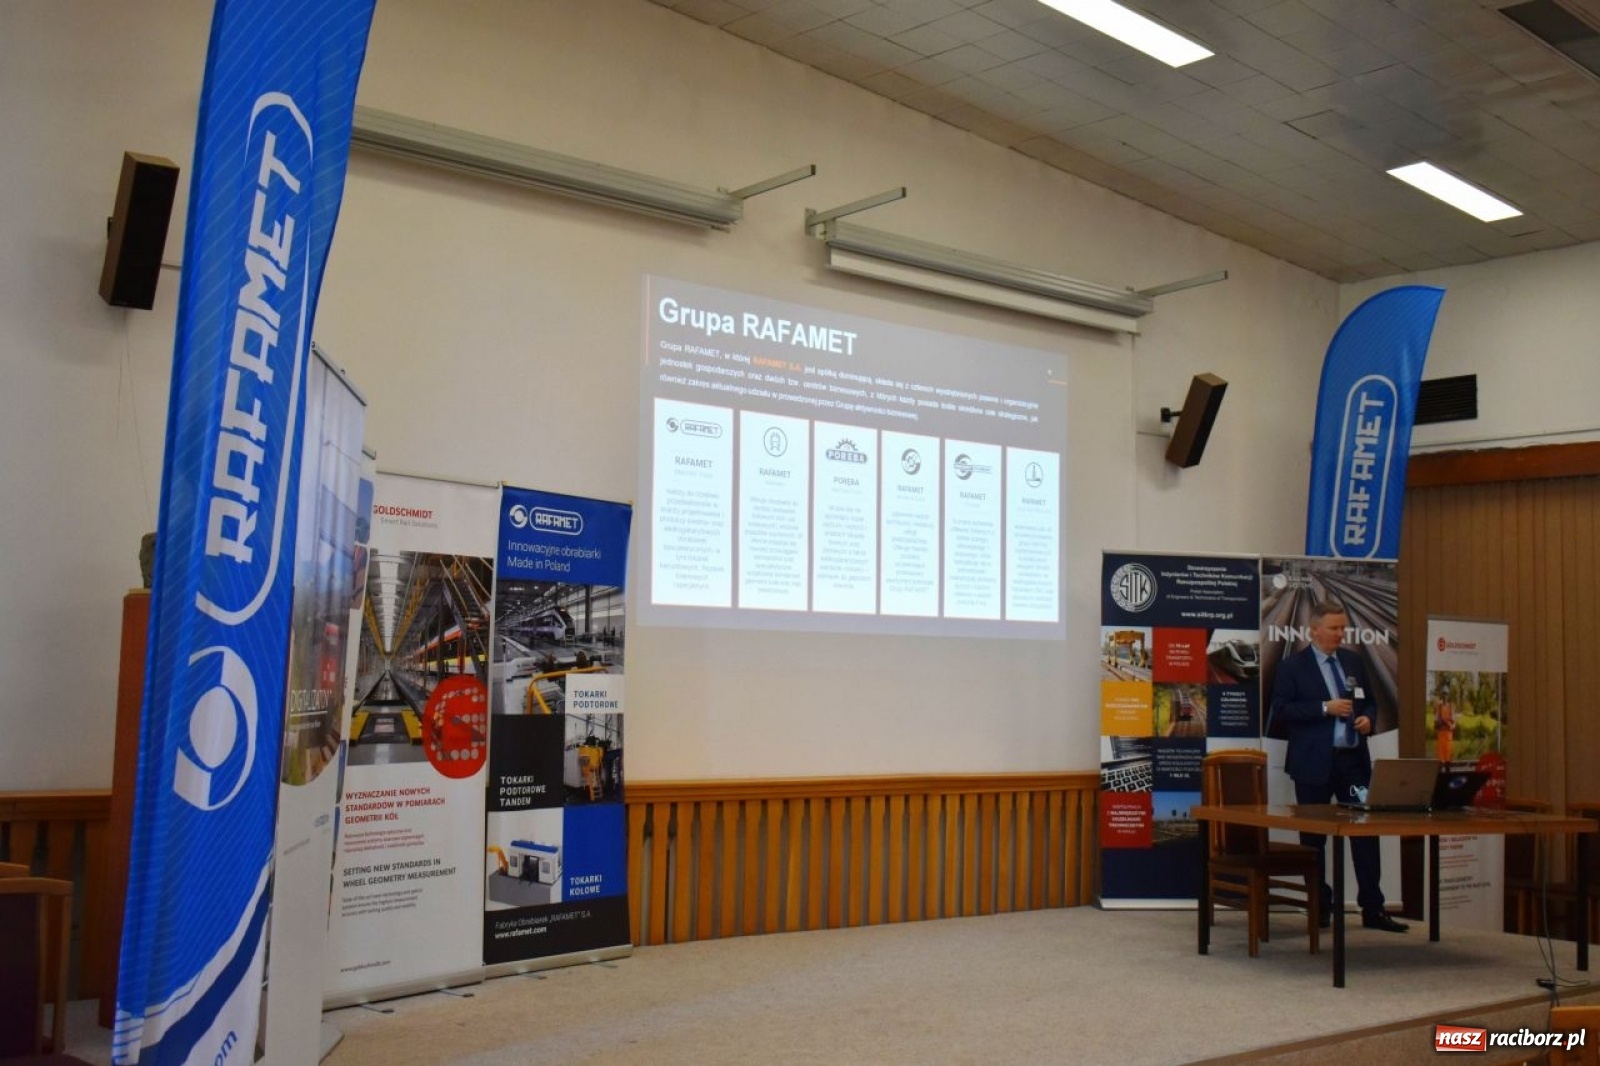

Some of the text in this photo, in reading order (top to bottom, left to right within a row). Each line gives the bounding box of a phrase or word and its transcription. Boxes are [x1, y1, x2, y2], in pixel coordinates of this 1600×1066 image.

[659, 297, 858, 355] Grupa RAFAMET
[205, 130, 300, 563] RAFAMET
[685, 422, 719, 435] RAFAMET
[674, 455, 713, 468] RAFAMET
[759, 468, 791, 479] RAFAMET
[1344, 391, 1385, 546] RAFAMET
[535, 513, 579, 529] RAFAMET
[508, 540, 601, 560] Innowacyjne obrabiarki
[507, 555, 571, 572] Made in Poland
[573, 690, 607, 698] TOKARKI
[573, 700, 619, 709] PODTOROWE
[500, 775, 534, 785] TOKARKI
[345, 787, 431, 800] WYZNACZANIE NOWYCH
[499, 785, 546, 796] PODTOROWE
[345, 796, 446, 812] STANDARDÓW W POMIARACH
[500, 797, 531, 807] TANDEM
[344, 813, 382, 825] GEOMETRII
[343, 858, 441, 877] SETTING NEW STANDARDS IN
[343, 867, 456, 888] WHEEL GEOMETRY MEASUREMENT
[570, 874, 602, 886] TOKARKI
[569, 885, 601, 897] KOŁOWE
[494, 926, 547, 939] www.rafamet.com
